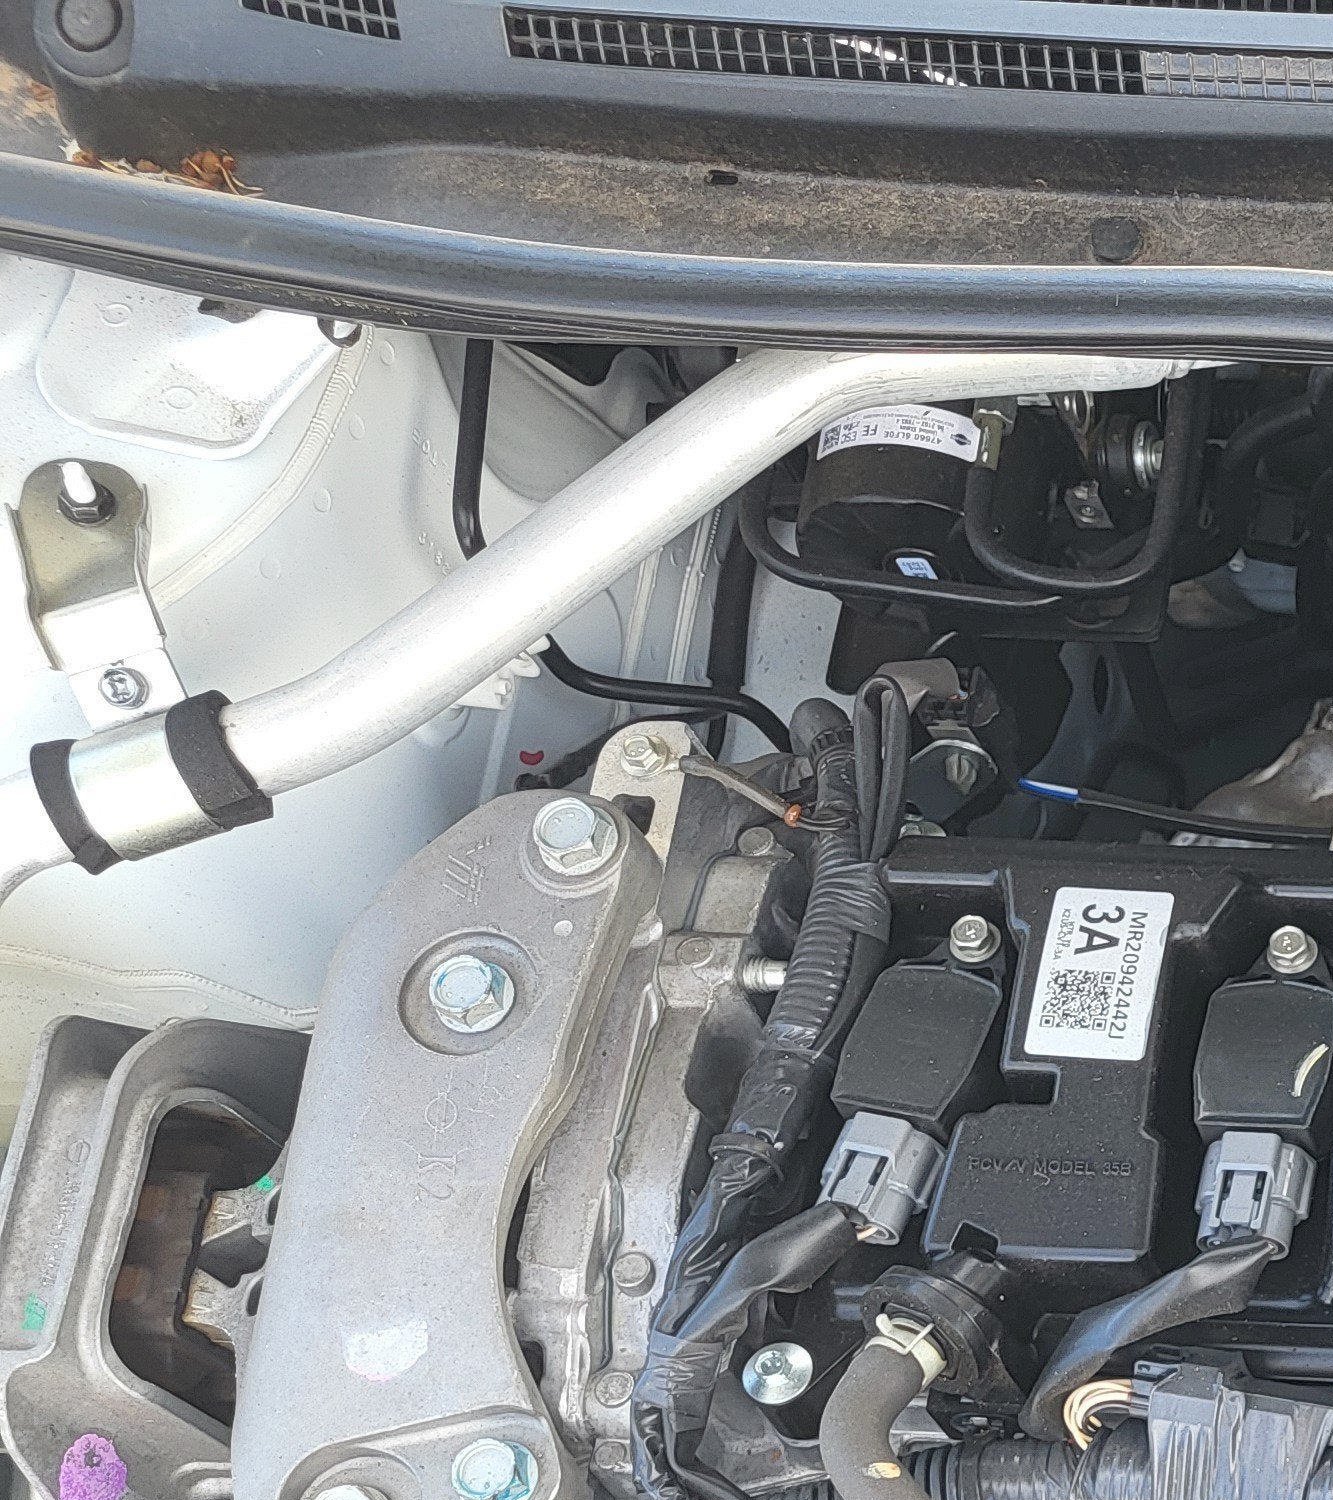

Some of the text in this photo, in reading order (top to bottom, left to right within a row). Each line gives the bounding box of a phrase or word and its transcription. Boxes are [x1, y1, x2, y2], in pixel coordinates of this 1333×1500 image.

[841, 431, 859, 445] ESC
[862, 424, 879, 437] FE
[1074, 902, 1126, 962] 3A
[1108, 911, 1148, 1041] MR20942442J
